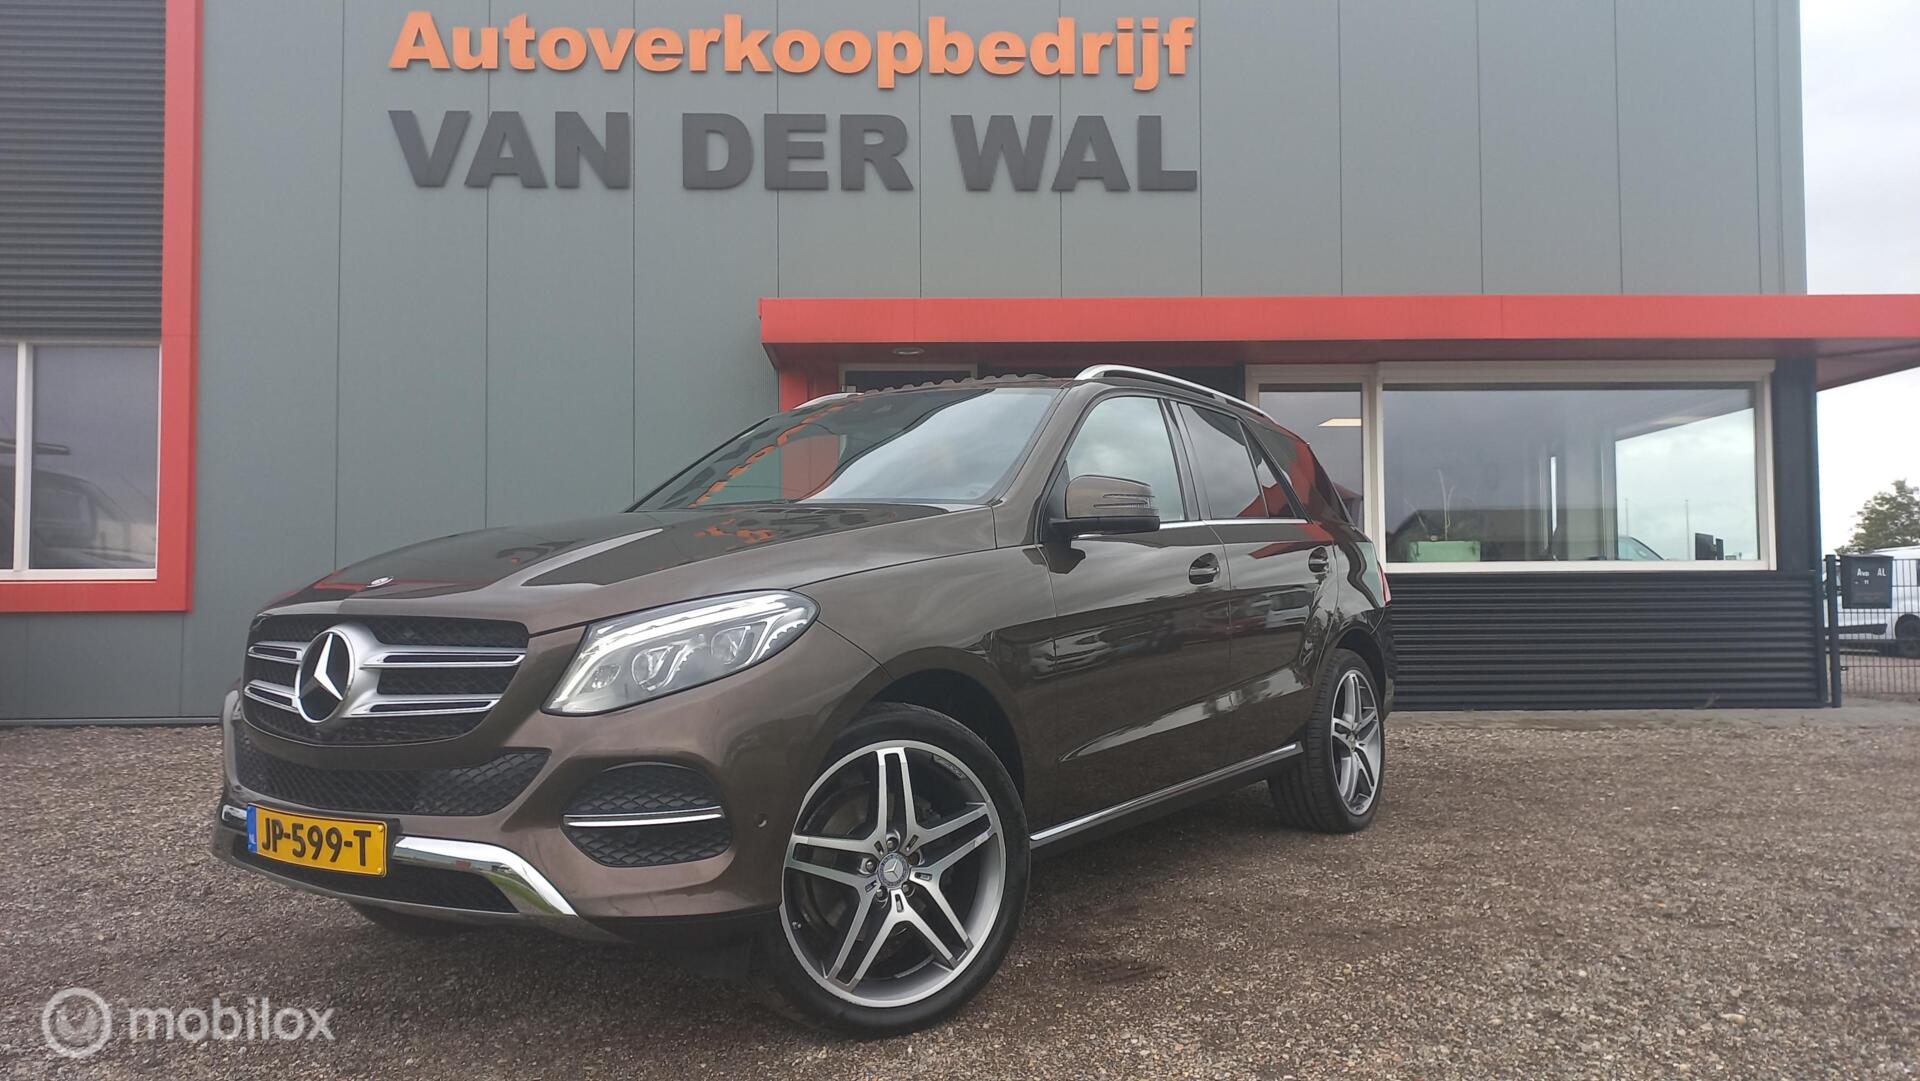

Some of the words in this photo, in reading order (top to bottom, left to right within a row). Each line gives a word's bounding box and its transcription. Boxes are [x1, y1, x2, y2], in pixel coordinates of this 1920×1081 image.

[388, 11, 1196, 91] Autoverkoopbedrijf
[388, 110, 631, 190] VAN
[682, 113, 914, 192] DER
[951, 115, 1199, 193] WAL
[261, 817, 372, 867] JP-599-T
